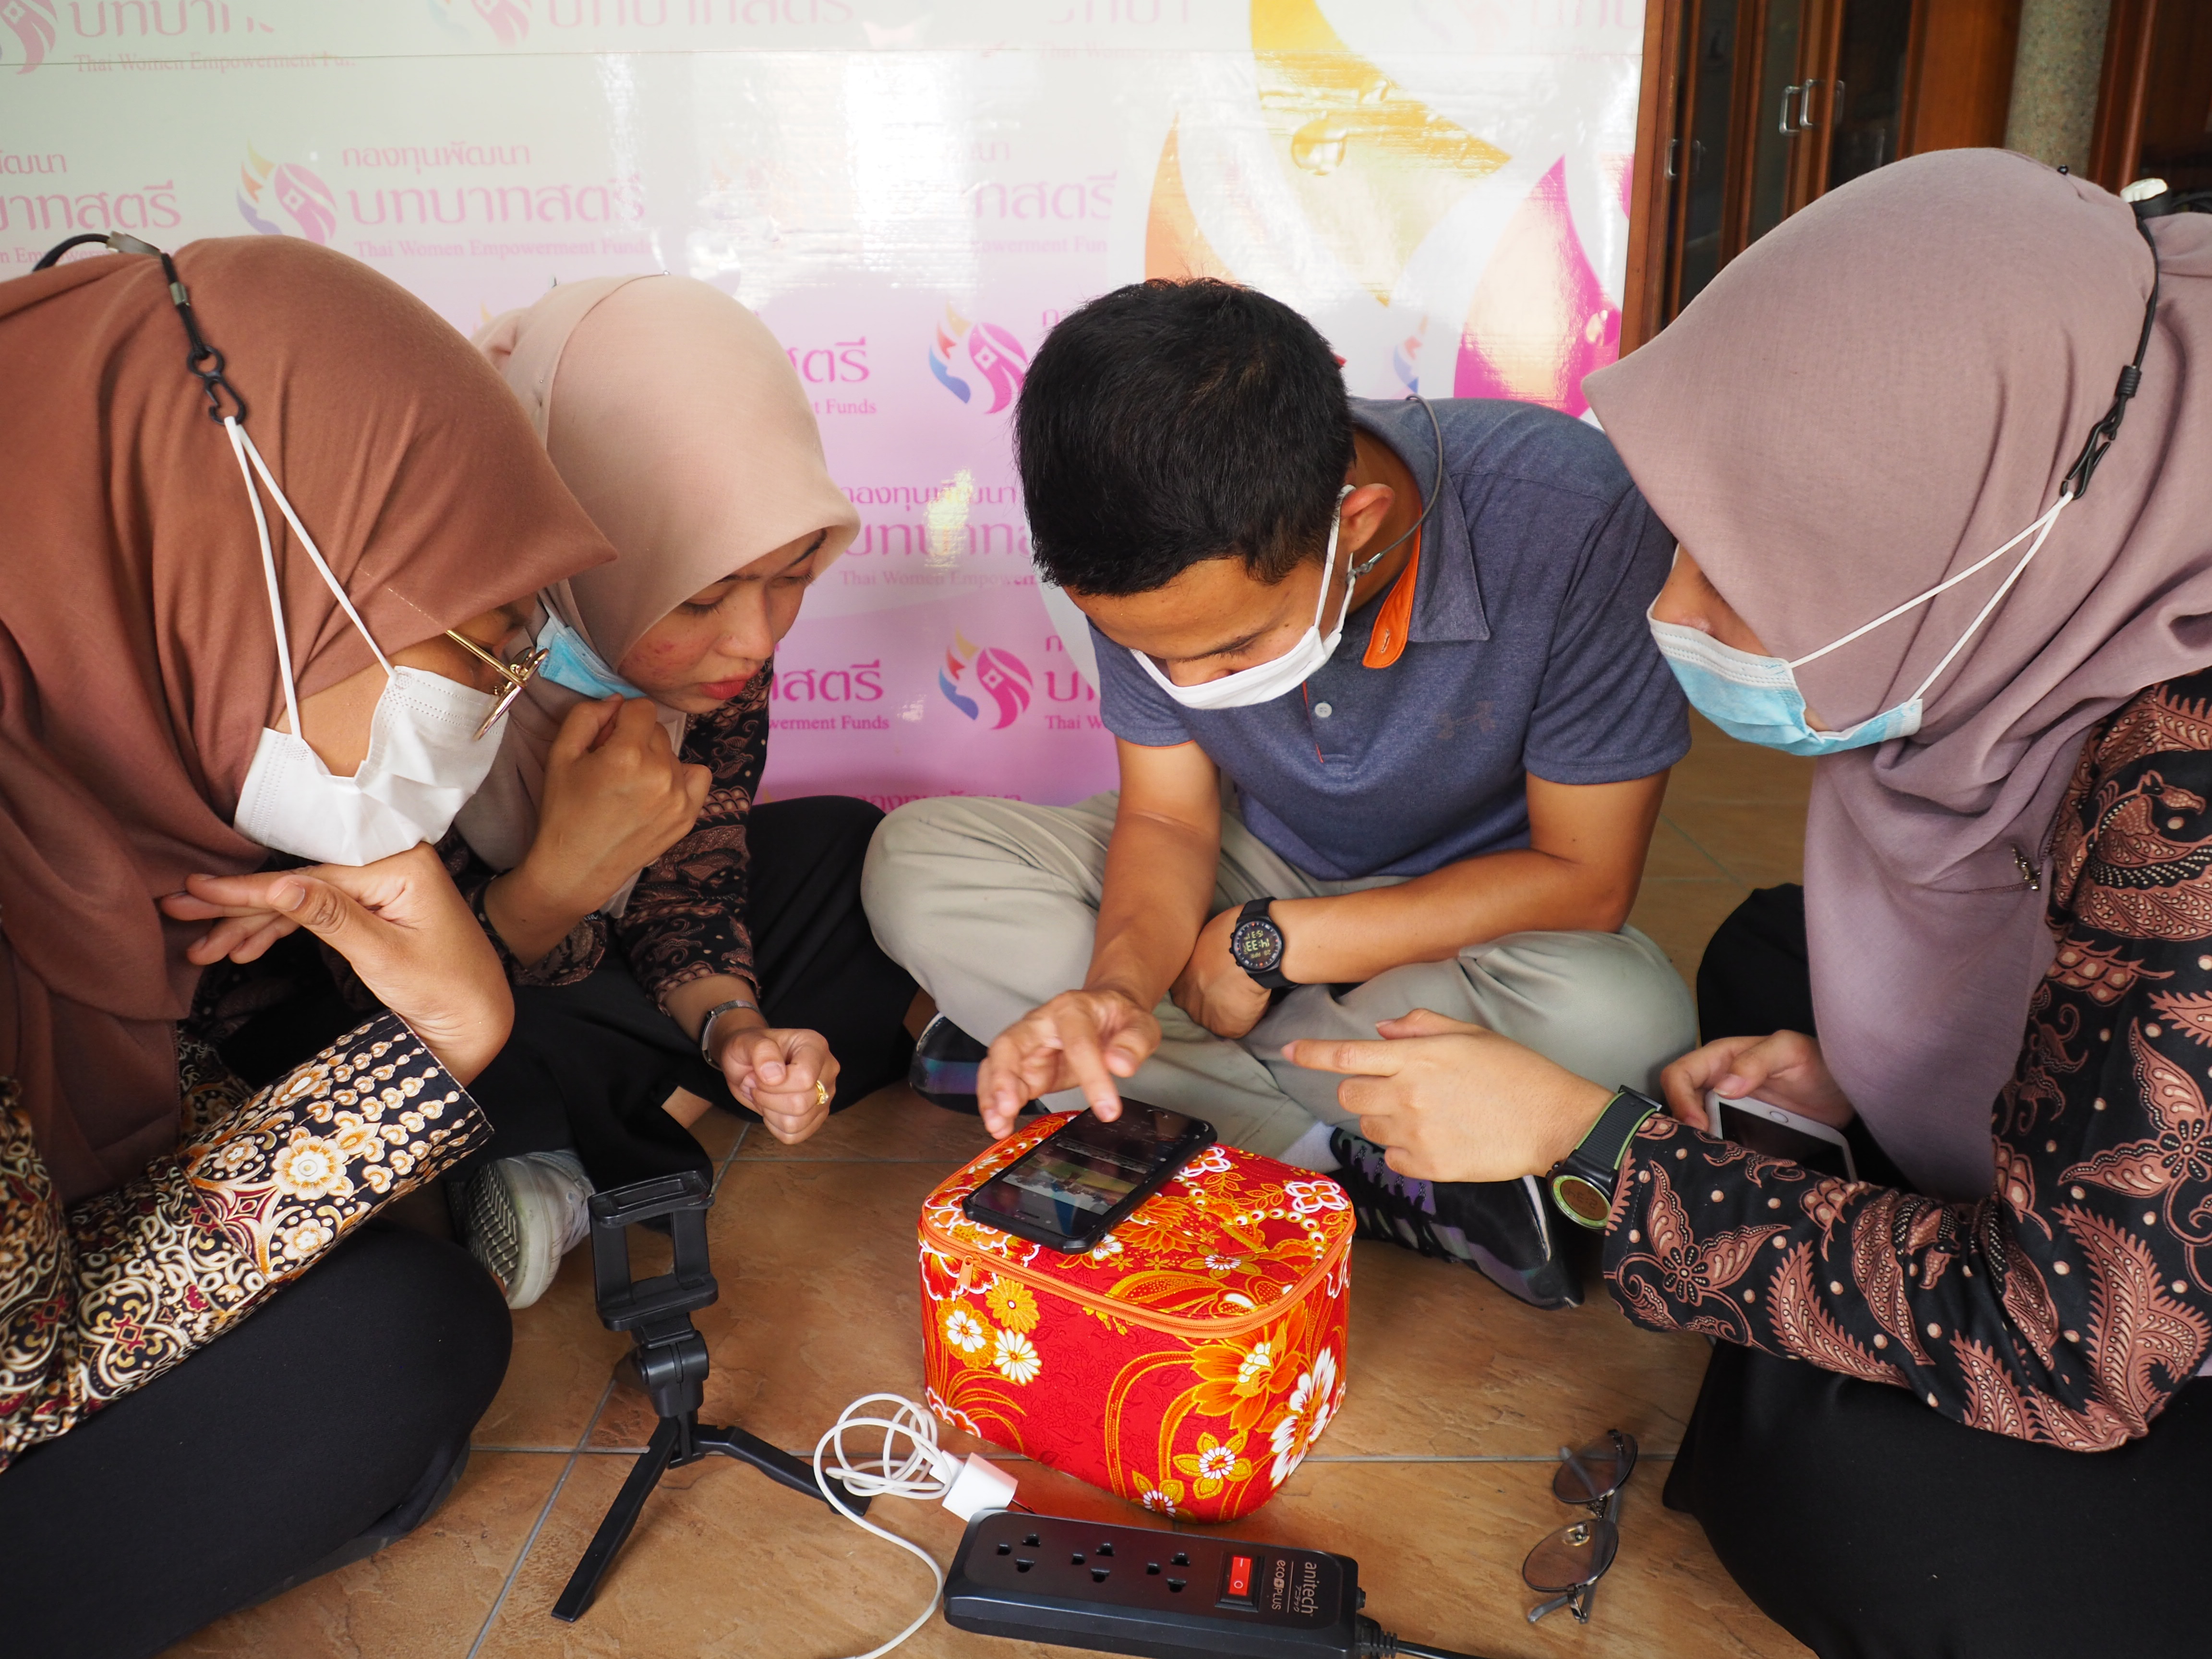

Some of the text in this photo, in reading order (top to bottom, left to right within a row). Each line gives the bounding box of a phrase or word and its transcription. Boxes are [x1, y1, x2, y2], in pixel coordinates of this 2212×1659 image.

[74, 54, 113, 72] Thai
[118, 53, 185, 72] Women
[190, 51, 317, 74] Empowerment
[353, 240, 393, 258] Thai
[398, 239, 464, 257] Women
[469, 238, 595, 261] Empowerment
[825, 398, 877, 414] Funds
[841, 715, 890, 730] Funds
[1044, 715, 1081, 730] Thai
[1301, 1562, 1320, 1614] anitech
